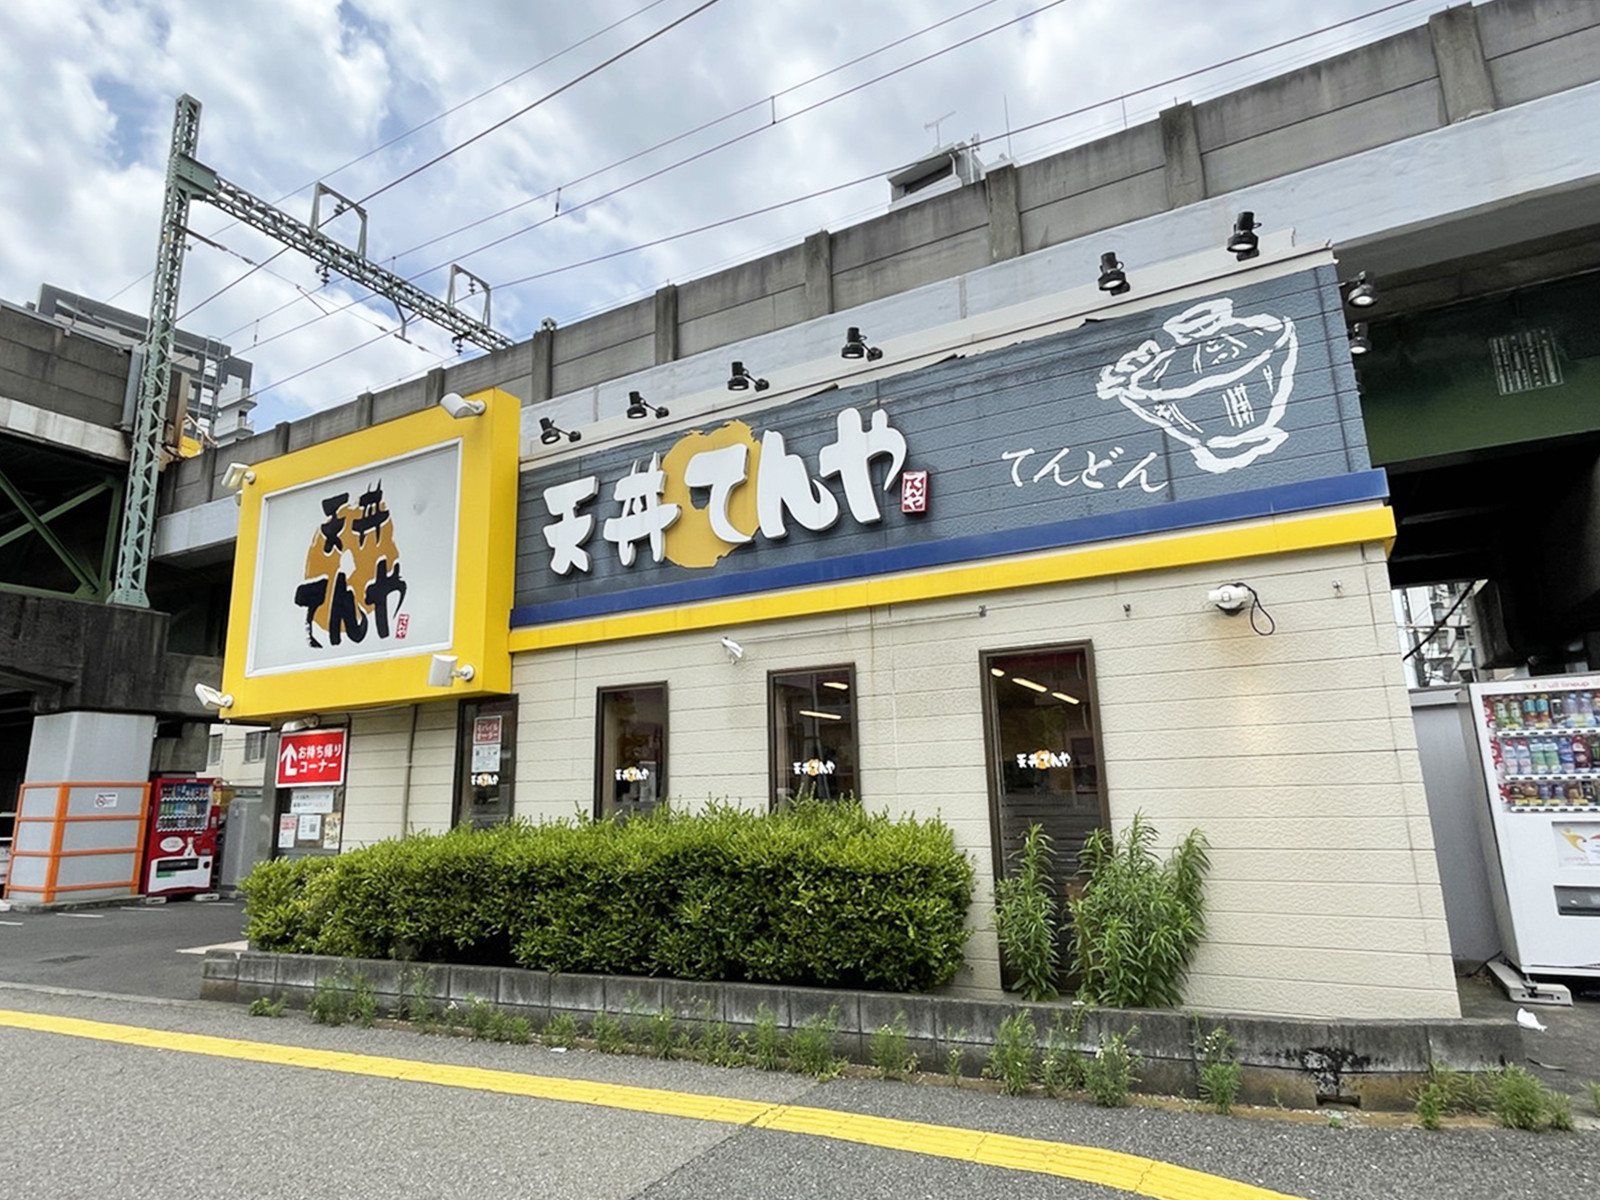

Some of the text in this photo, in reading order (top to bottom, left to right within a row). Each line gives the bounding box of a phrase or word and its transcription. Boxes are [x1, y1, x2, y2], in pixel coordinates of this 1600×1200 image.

[543, 407, 907, 576] 天丼てんや
[1002, 446, 1168, 492] てんどん
[320, 478, 390, 554] 天丼
[294, 556, 408, 649] てんや
[298, 743, 341, 759] お持ち帰り
[299, 759, 337, 773] コーナー
